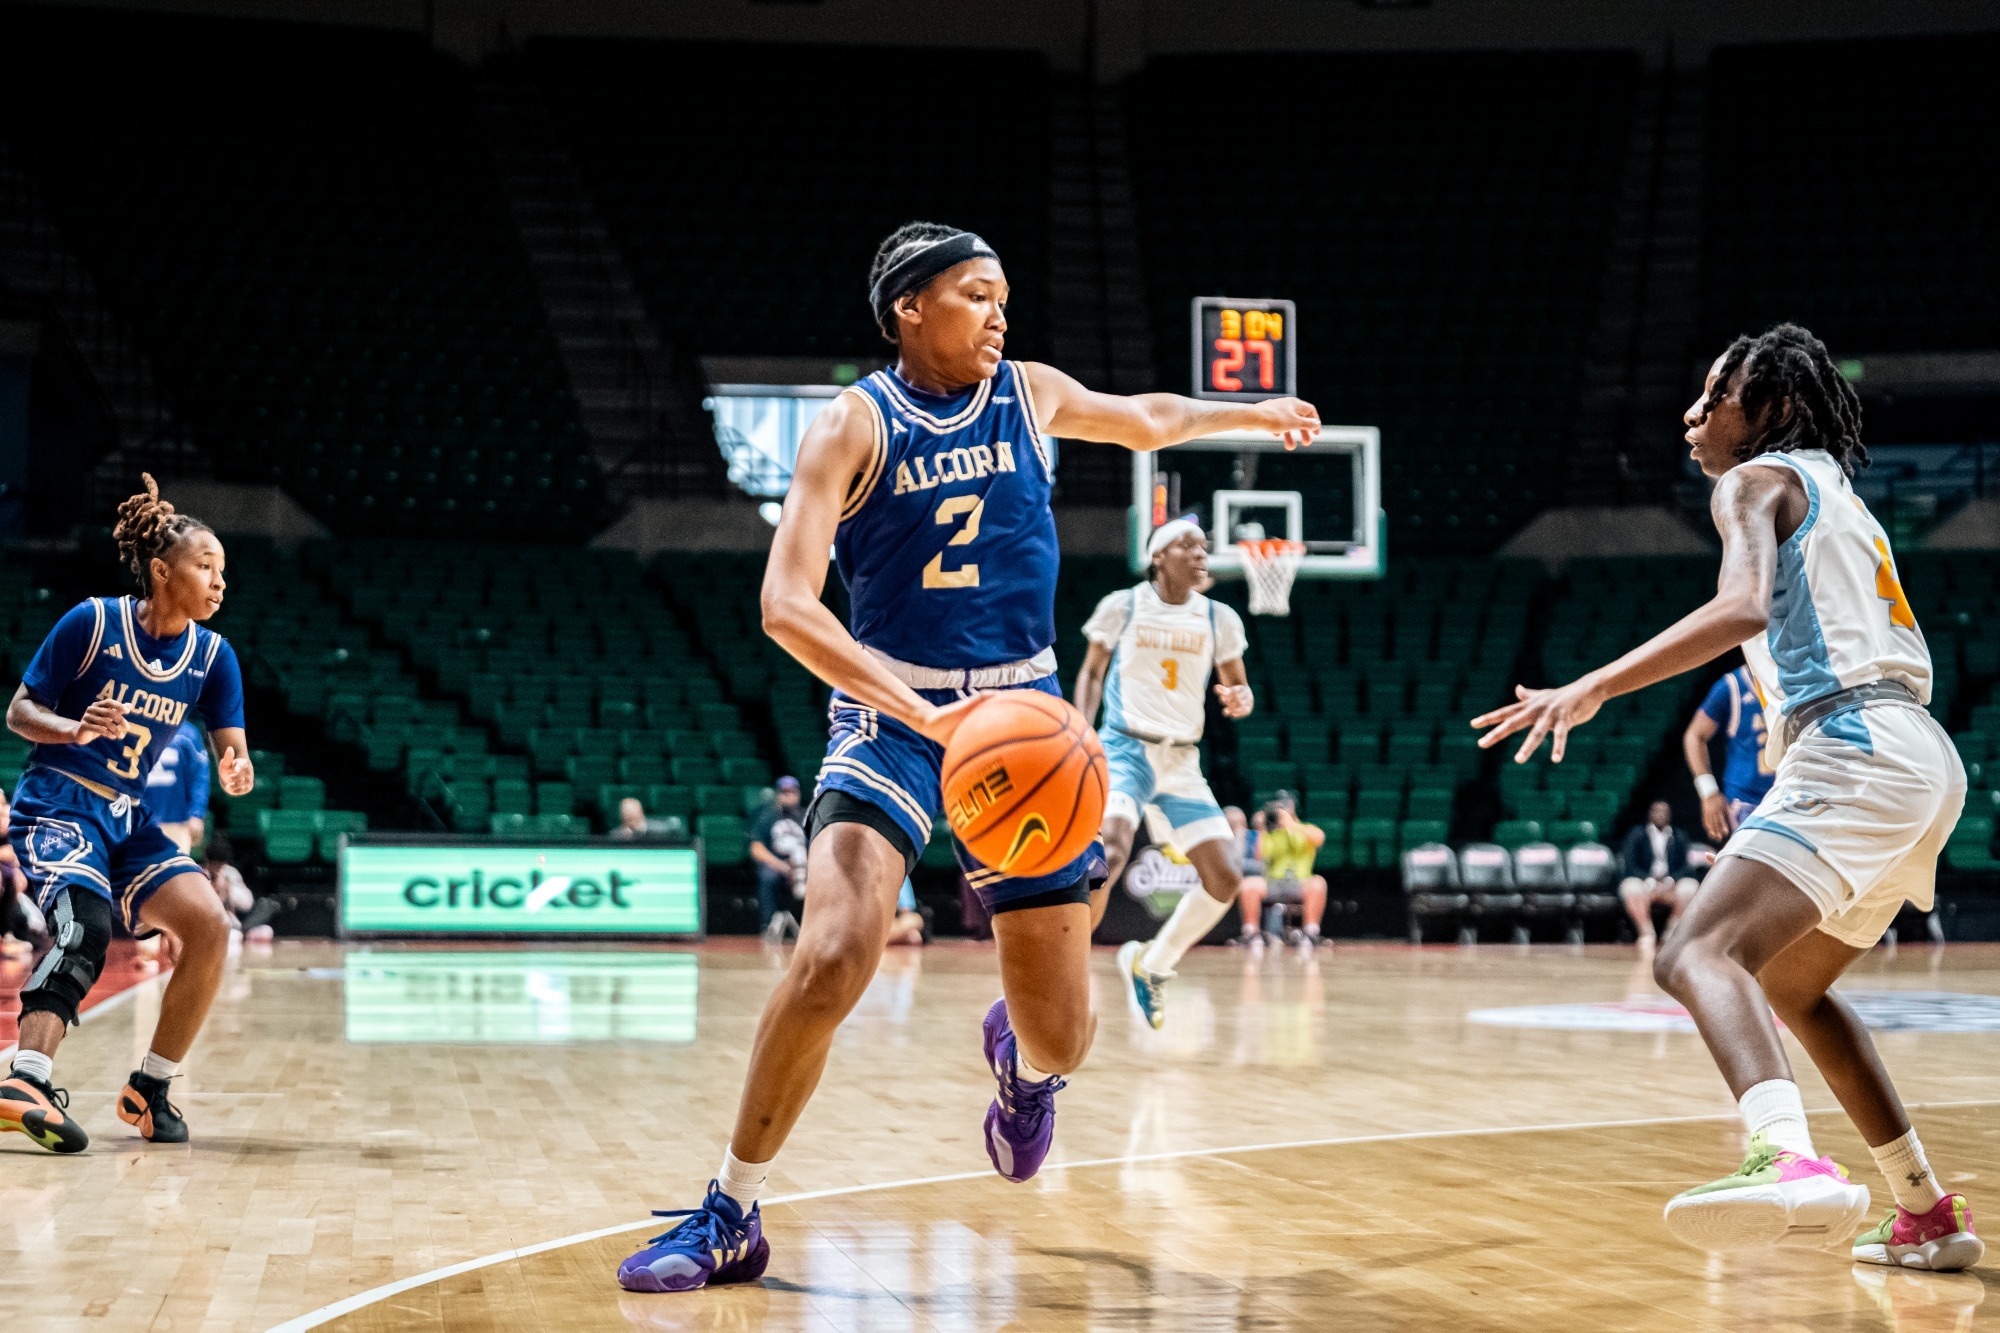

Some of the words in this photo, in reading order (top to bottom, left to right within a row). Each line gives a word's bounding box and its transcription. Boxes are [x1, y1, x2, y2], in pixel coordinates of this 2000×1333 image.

[1211, 338, 1275, 391] 27
[893, 441, 1017, 496] ALCORN
[922, 494, 985, 590] 2
[1160, 658, 1179, 691] 3
[96, 679, 188, 726] ALCORN
[106, 721, 153, 780] 3
[949, 767, 1016, 831] ELITE
[40, 832, 70, 851] ALCON
[403, 868, 639, 910] cricket
